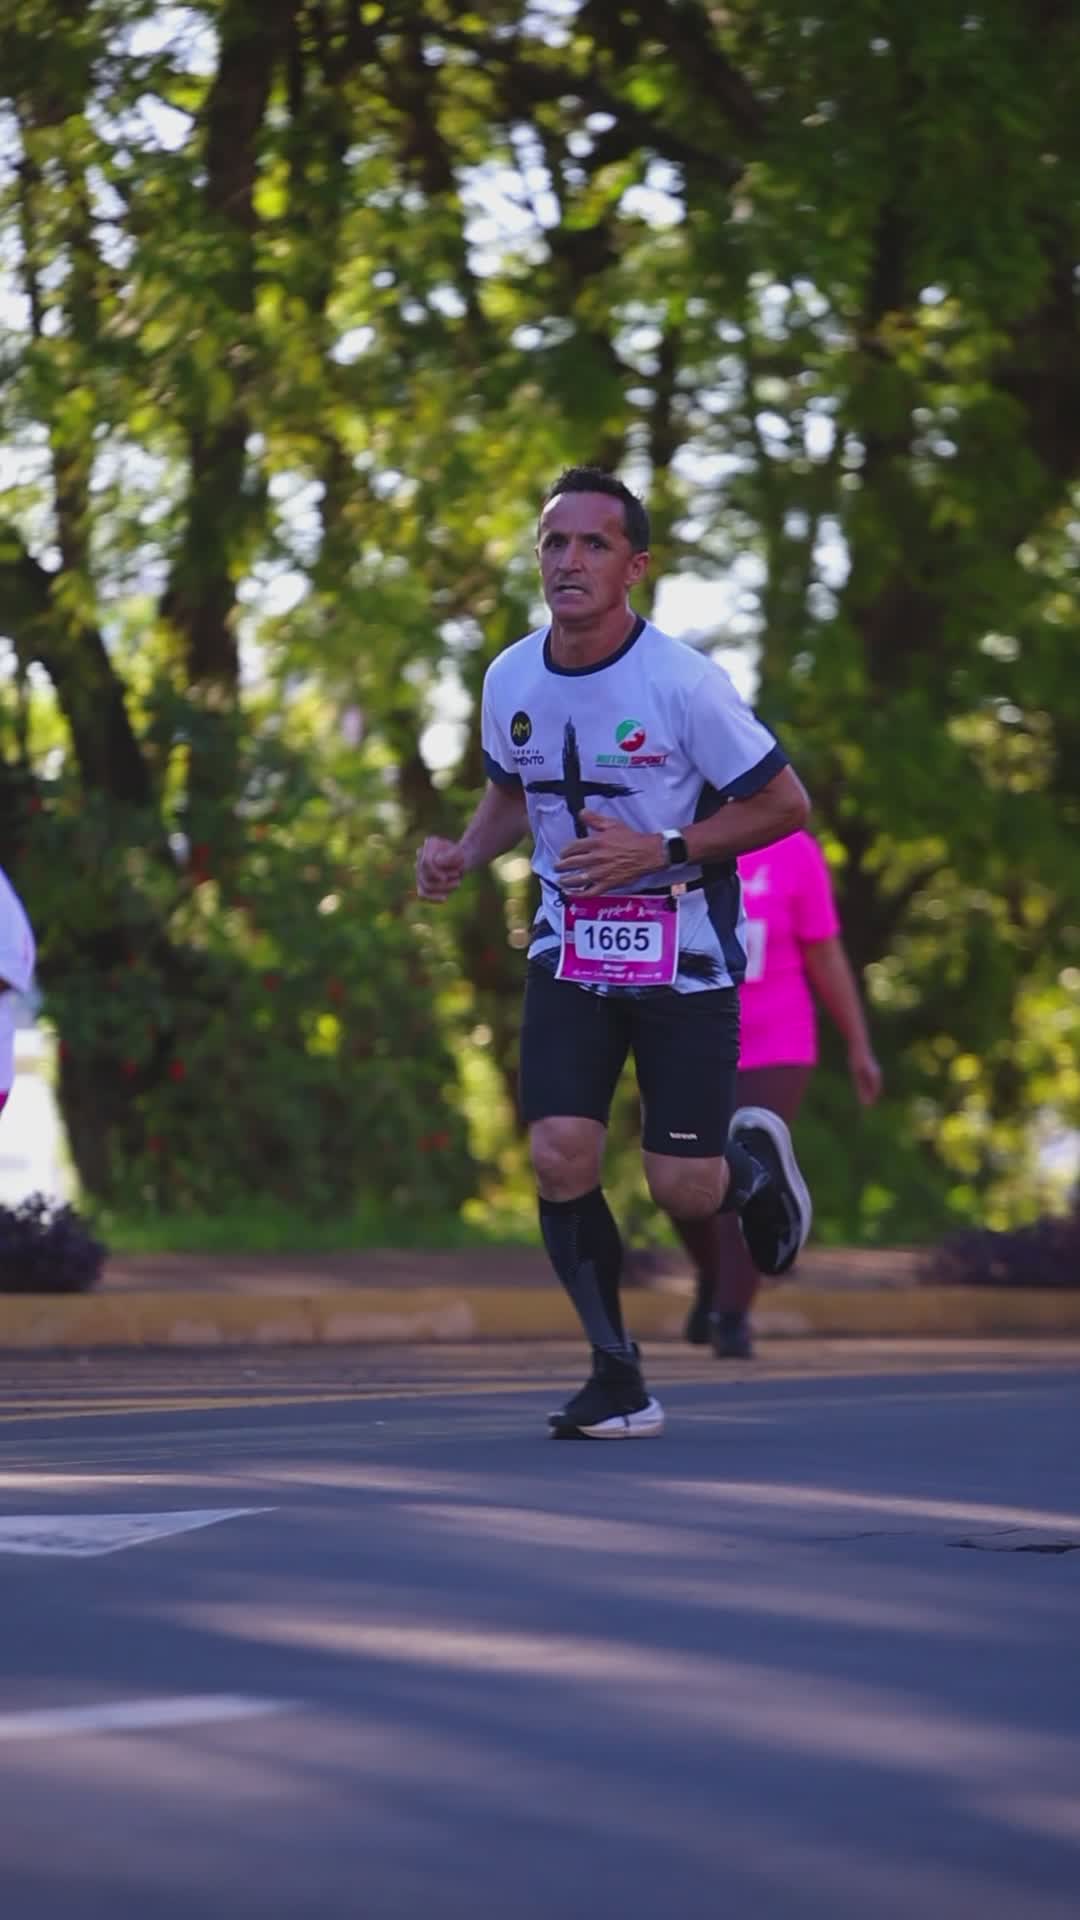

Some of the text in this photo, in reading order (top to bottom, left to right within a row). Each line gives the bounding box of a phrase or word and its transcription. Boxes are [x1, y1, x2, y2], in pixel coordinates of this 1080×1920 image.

[512, 721, 530, 737] AM
[630, 754, 669, 765] SPORT
[584, 925, 650, 951] 1665
